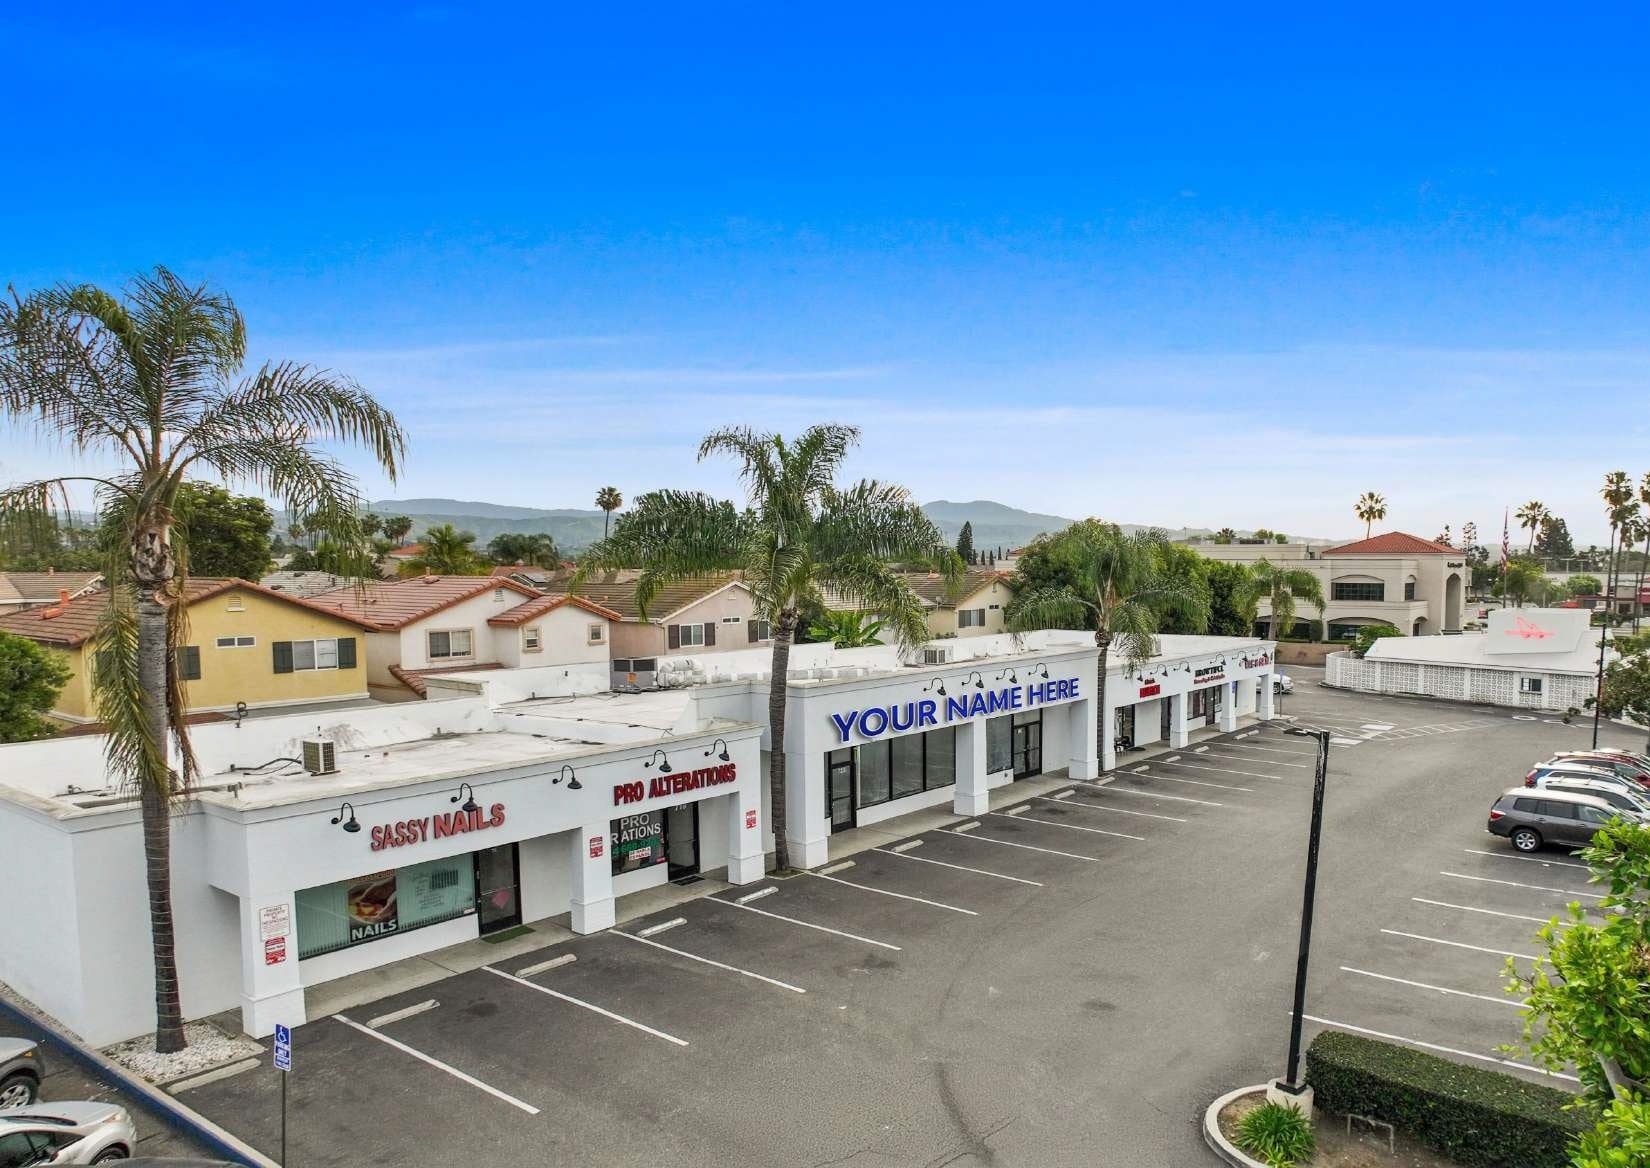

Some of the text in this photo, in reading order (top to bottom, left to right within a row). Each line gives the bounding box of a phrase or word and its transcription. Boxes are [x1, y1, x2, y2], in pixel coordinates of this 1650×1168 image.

[831, 678, 1080, 743] YOUR NAME HERE
[613, 763, 737, 806] PRO ALTERATIONS
[371, 803, 505, 852] SASSY NAILS
[621, 813, 649, 829] PRO
[352, 919, 397, 941] NAILS
